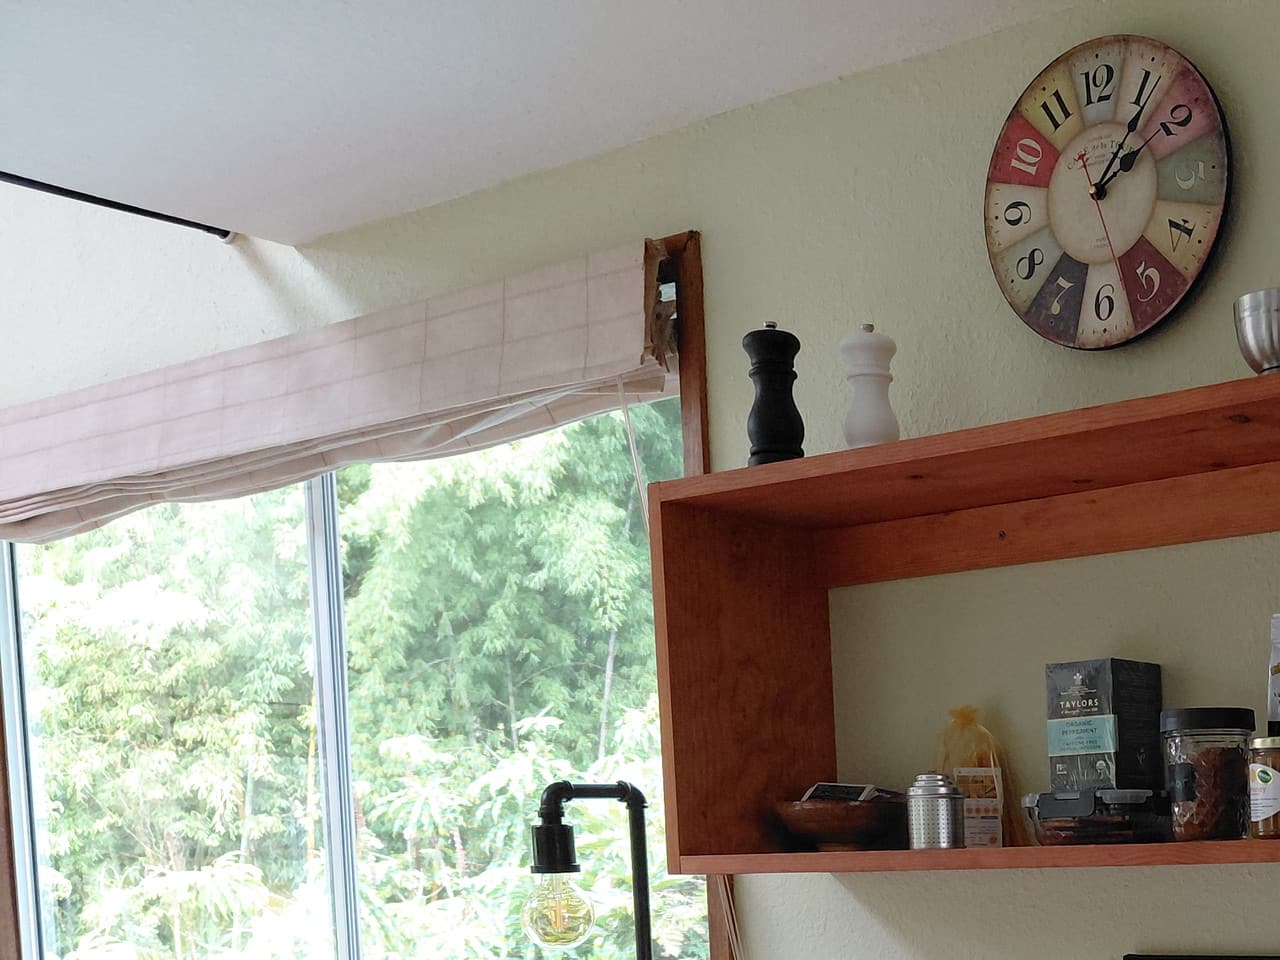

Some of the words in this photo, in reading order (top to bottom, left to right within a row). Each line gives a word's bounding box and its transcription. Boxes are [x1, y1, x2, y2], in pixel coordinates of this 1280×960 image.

[1080, 64, 1114, 107] 12
[1130, 68, 1151, 107] 1
[1040, 89, 1073, 133] 11
[1159, 103, 1193, 136] 2
[1009, 137, 1044, 176] 10
[1003, 200, 1032, 227] 9
[1167, 216, 1197, 252] 4
[1015, 248, 1044, 281] 8
[1135, 261, 1162, 302] 5
[1050, 276, 1075, 316] 7
[1094, 283, 1116, 321] 6
[1059, 698, 1099, 710] TAYLORS
